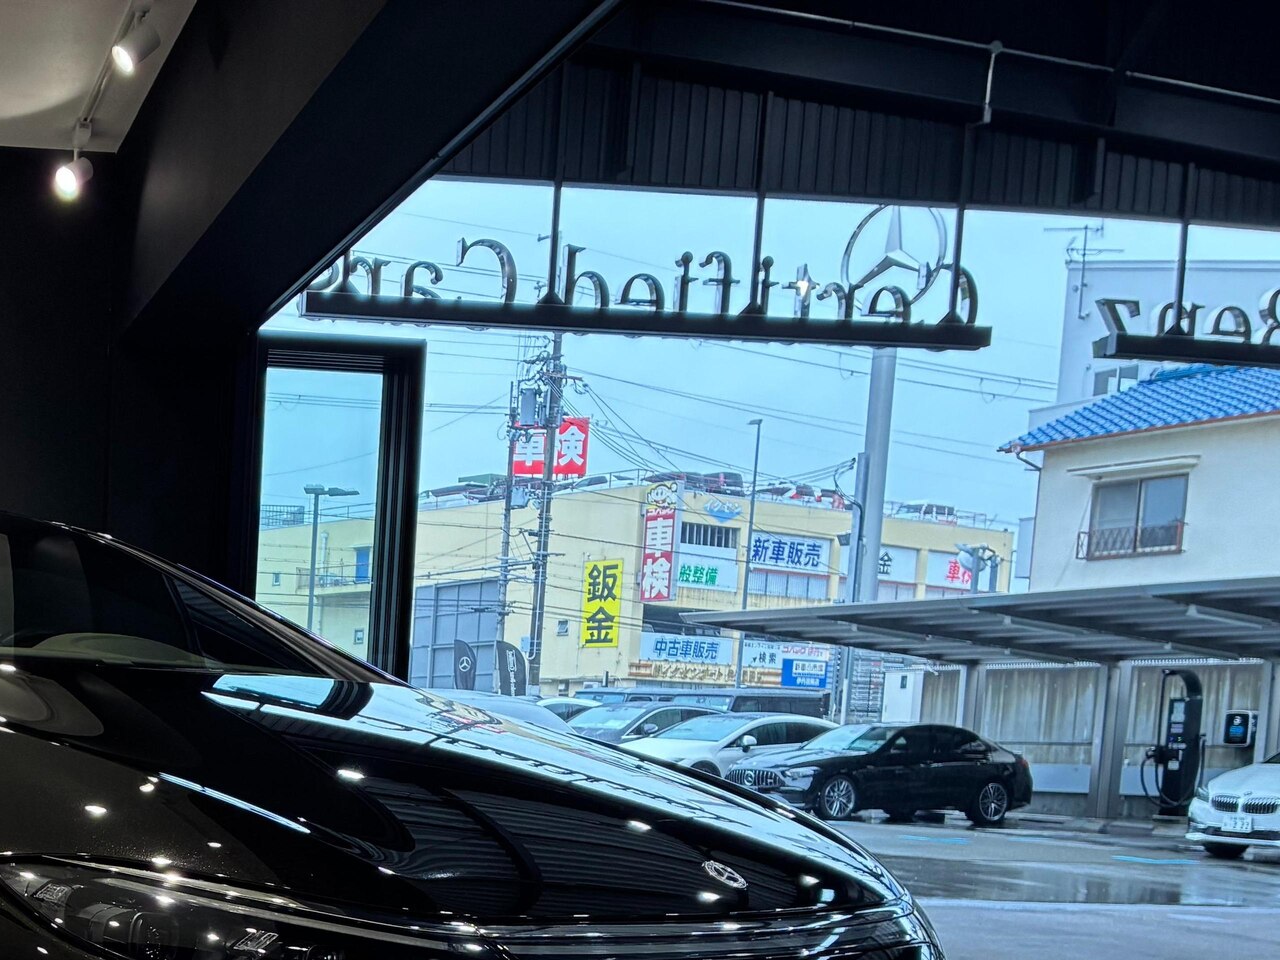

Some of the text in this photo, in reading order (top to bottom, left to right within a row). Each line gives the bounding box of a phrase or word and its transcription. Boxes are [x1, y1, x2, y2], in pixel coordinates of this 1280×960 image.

[513, 426, 586, 467] 車検
[642, 517, 674, 598] 車検
[751, 536, 822, 568] 新車販売
[585, 563, 619, 644] 鈑金
[653, 636, 720, 660] 中古車販売
